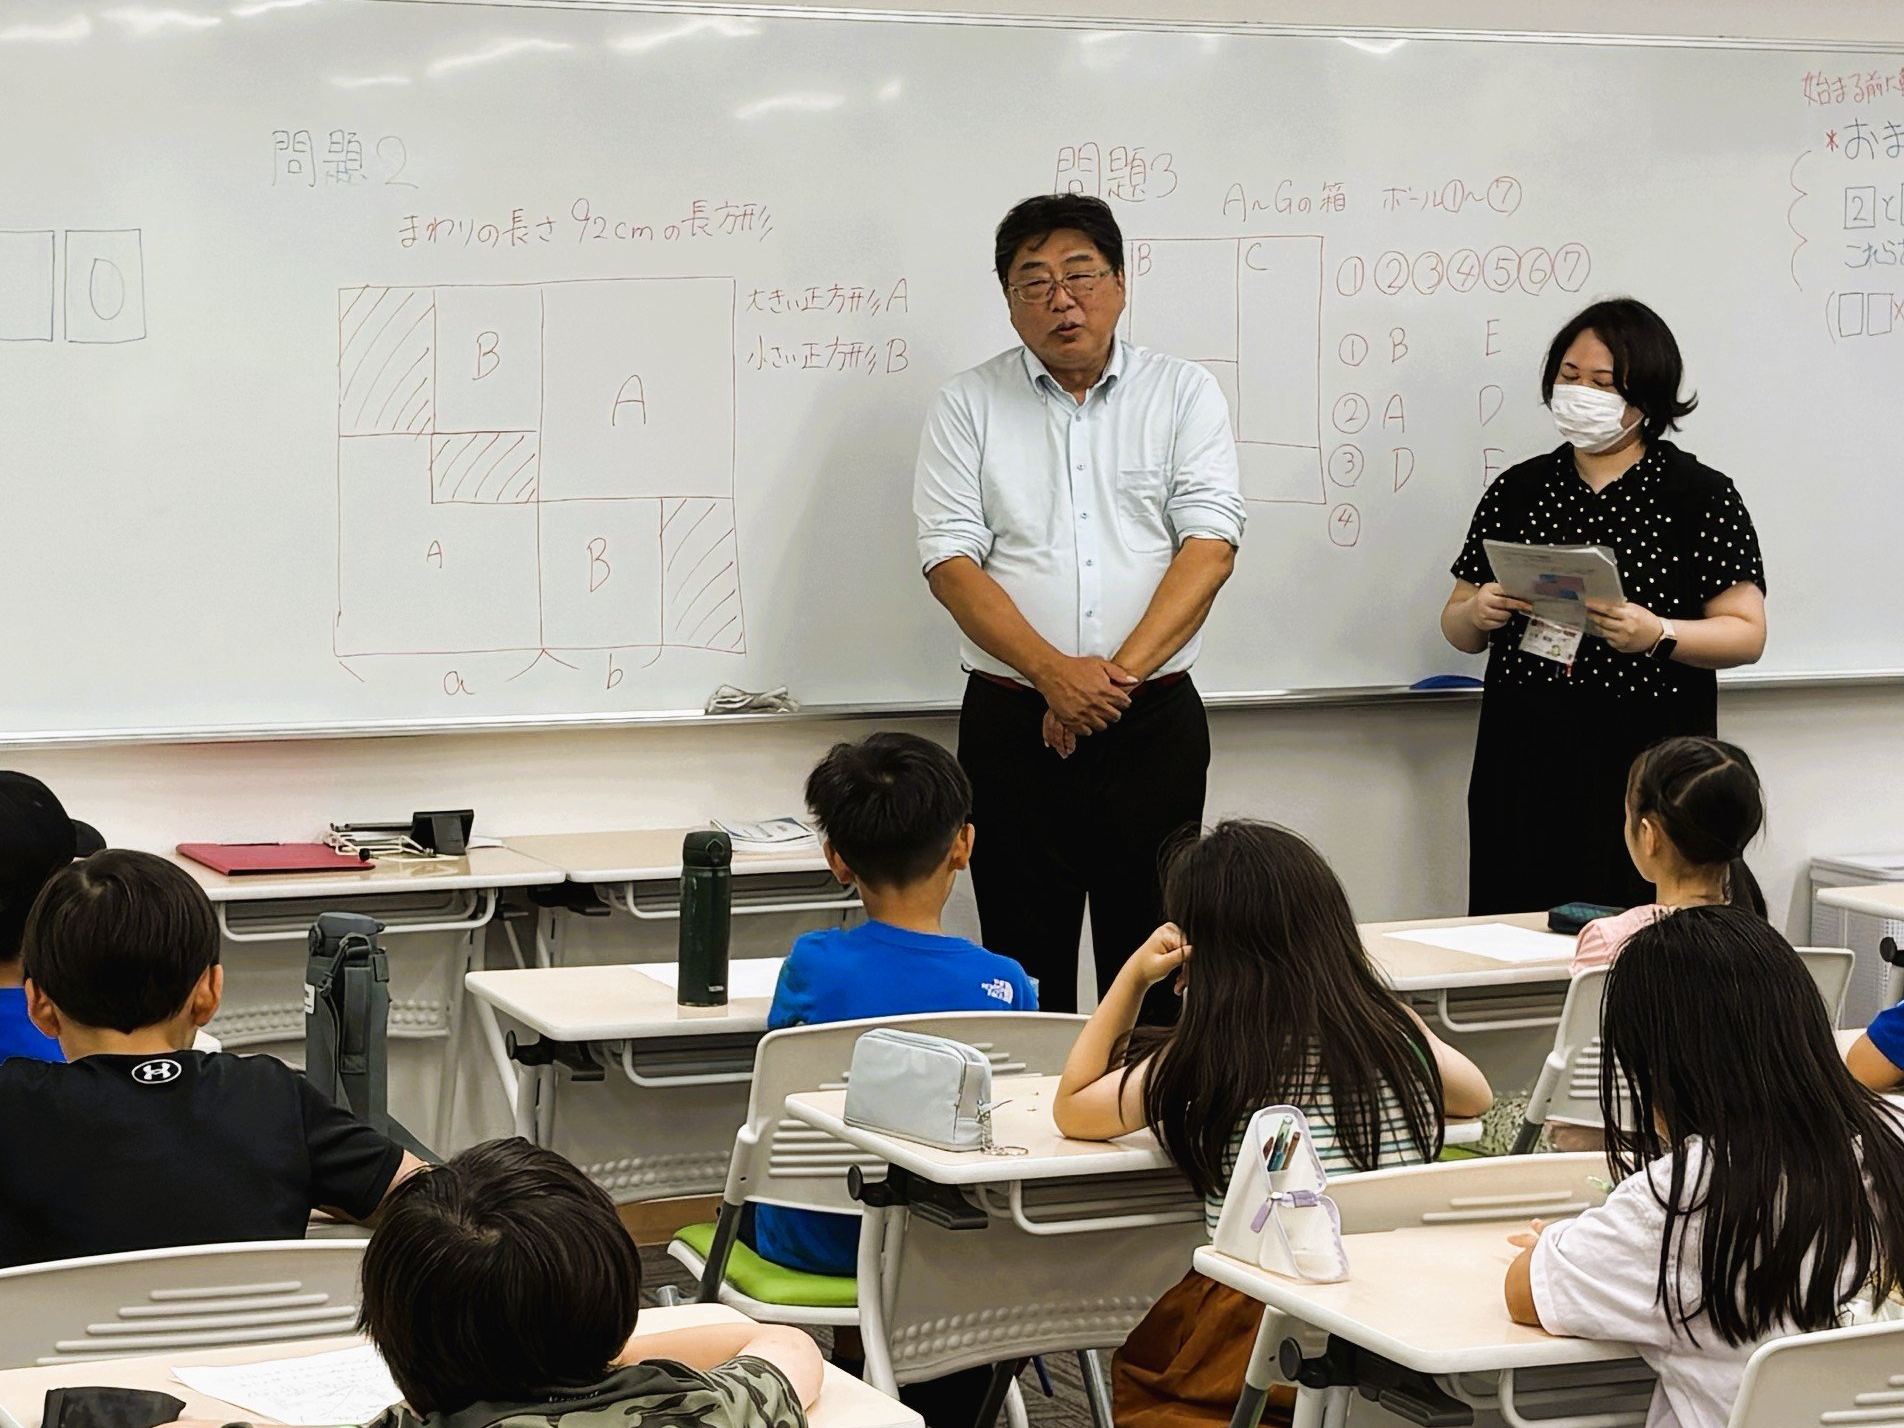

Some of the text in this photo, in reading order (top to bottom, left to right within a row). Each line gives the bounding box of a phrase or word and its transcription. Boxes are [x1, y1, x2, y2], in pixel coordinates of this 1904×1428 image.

[272, 129, 419, 188] 問題2
[1054, 142, 1178, 202] 問題3
[1137, 243, 1153, 275] B
[1245, 242, 1268, 271] C
[472, 331, 501, 381] B
[1390, 327, 1408, 363] B
[1485, 319, 1501, 356] E
[612, 375, 647, 427] A
[1382, 394, 1406, 434] A
[1478, 385, 1504, 427] D
[1393, 447, 1415, 494] D
[426, 540, 444, 570] A
[586, 538, 611, 593] B
[443, 669, 475, 696] a
[605, 652, 625, 690] b
